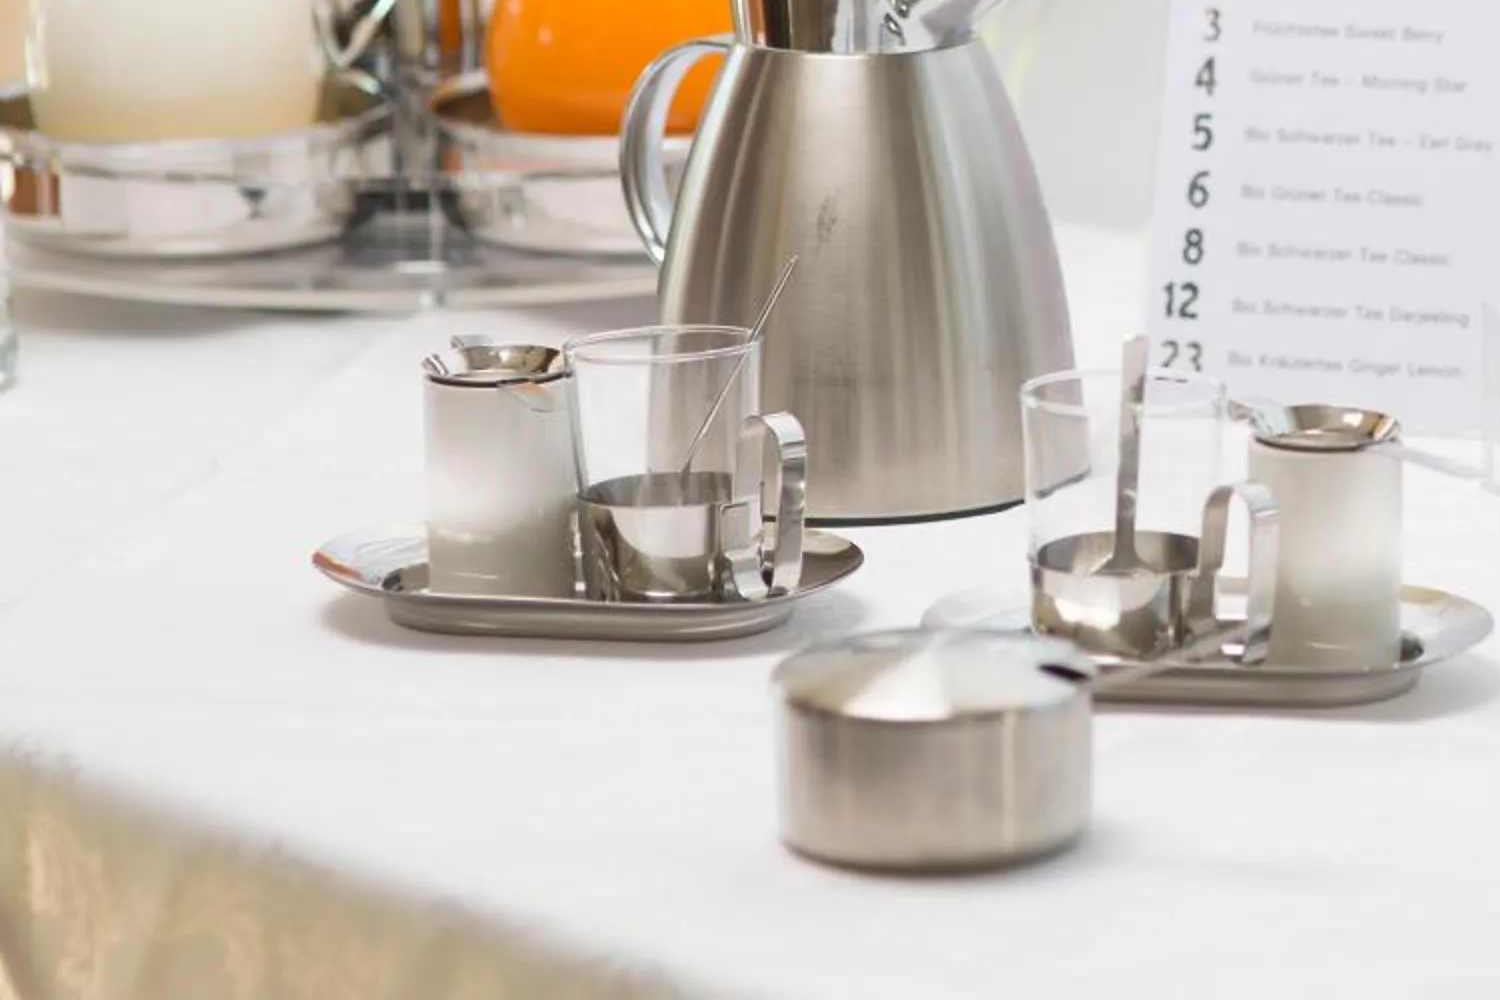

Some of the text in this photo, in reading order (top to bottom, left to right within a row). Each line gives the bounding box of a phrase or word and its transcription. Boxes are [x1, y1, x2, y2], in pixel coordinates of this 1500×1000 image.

[1203, 8, 1221, 42] 3
[1402, 25, 1446, 45] Berry
[1194, 56, 1217, 96] 4
[1311, 70, 1340, 87] Tee
[1361, 73, 1428, 96] Morning
[1434, 75, 1468, 93] Star
[1191, 113, 1213, 151] 5
[1368, 130, 1396, 147] Tee
[1419, 133, 1450, 150] Earl
[1188, 171, 1211, 209] 6
[1182, 228, 1205, 265] 8
[1360, 245, 1388, 262] Tee
[1162, 282, 1200, 320] 12
[1354, 303, 1383, 320] Tee
[1160, 340, 1204, 374] 23
[1348, 357, 1401, 377] Ginger
[1407, 361, 1464, 380] Lemon
